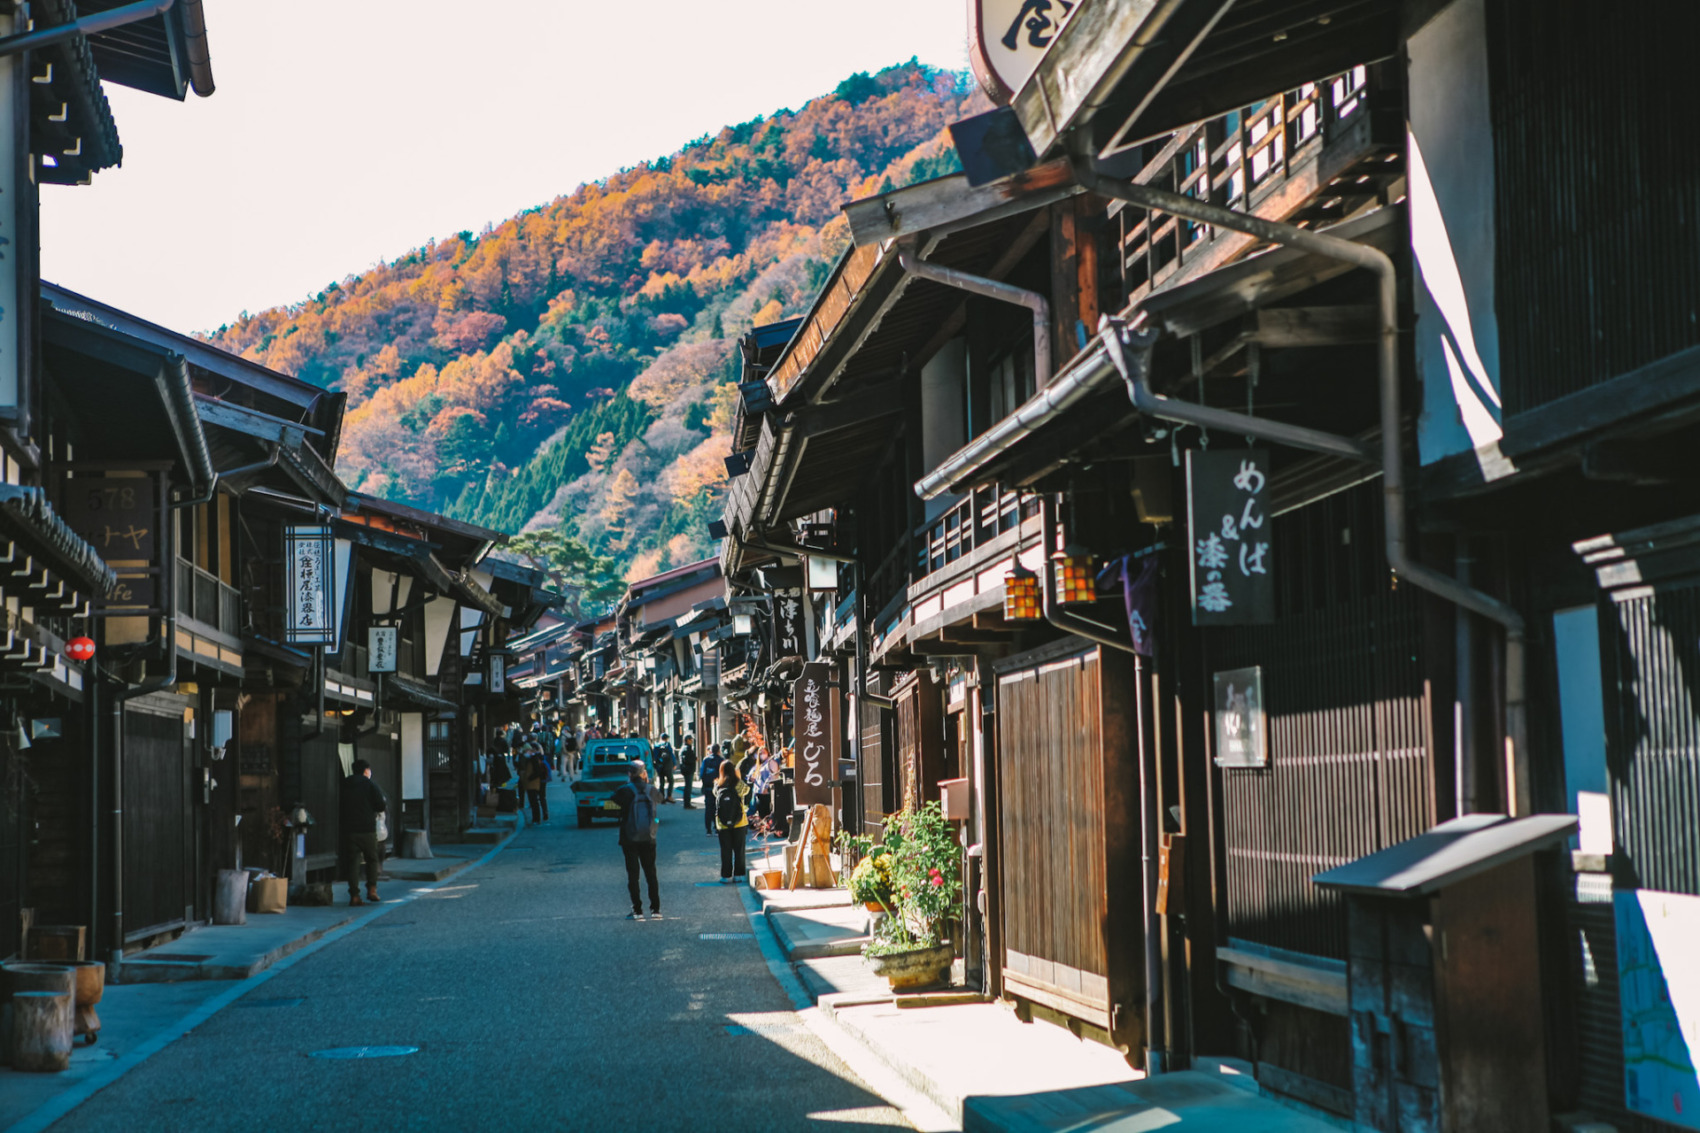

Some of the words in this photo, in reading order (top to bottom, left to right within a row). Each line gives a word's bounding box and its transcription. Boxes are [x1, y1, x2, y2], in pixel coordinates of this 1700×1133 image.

[88, 486, 136, 511] 578
[1233, 458, 1269, 577] めんば
[1220, 513, 1240, 541] &
[1196, 532, 1233, 613] 漆の器
[779, 598, 799, 654] 津ち川
[803, 741, 825, 787] ひろ
